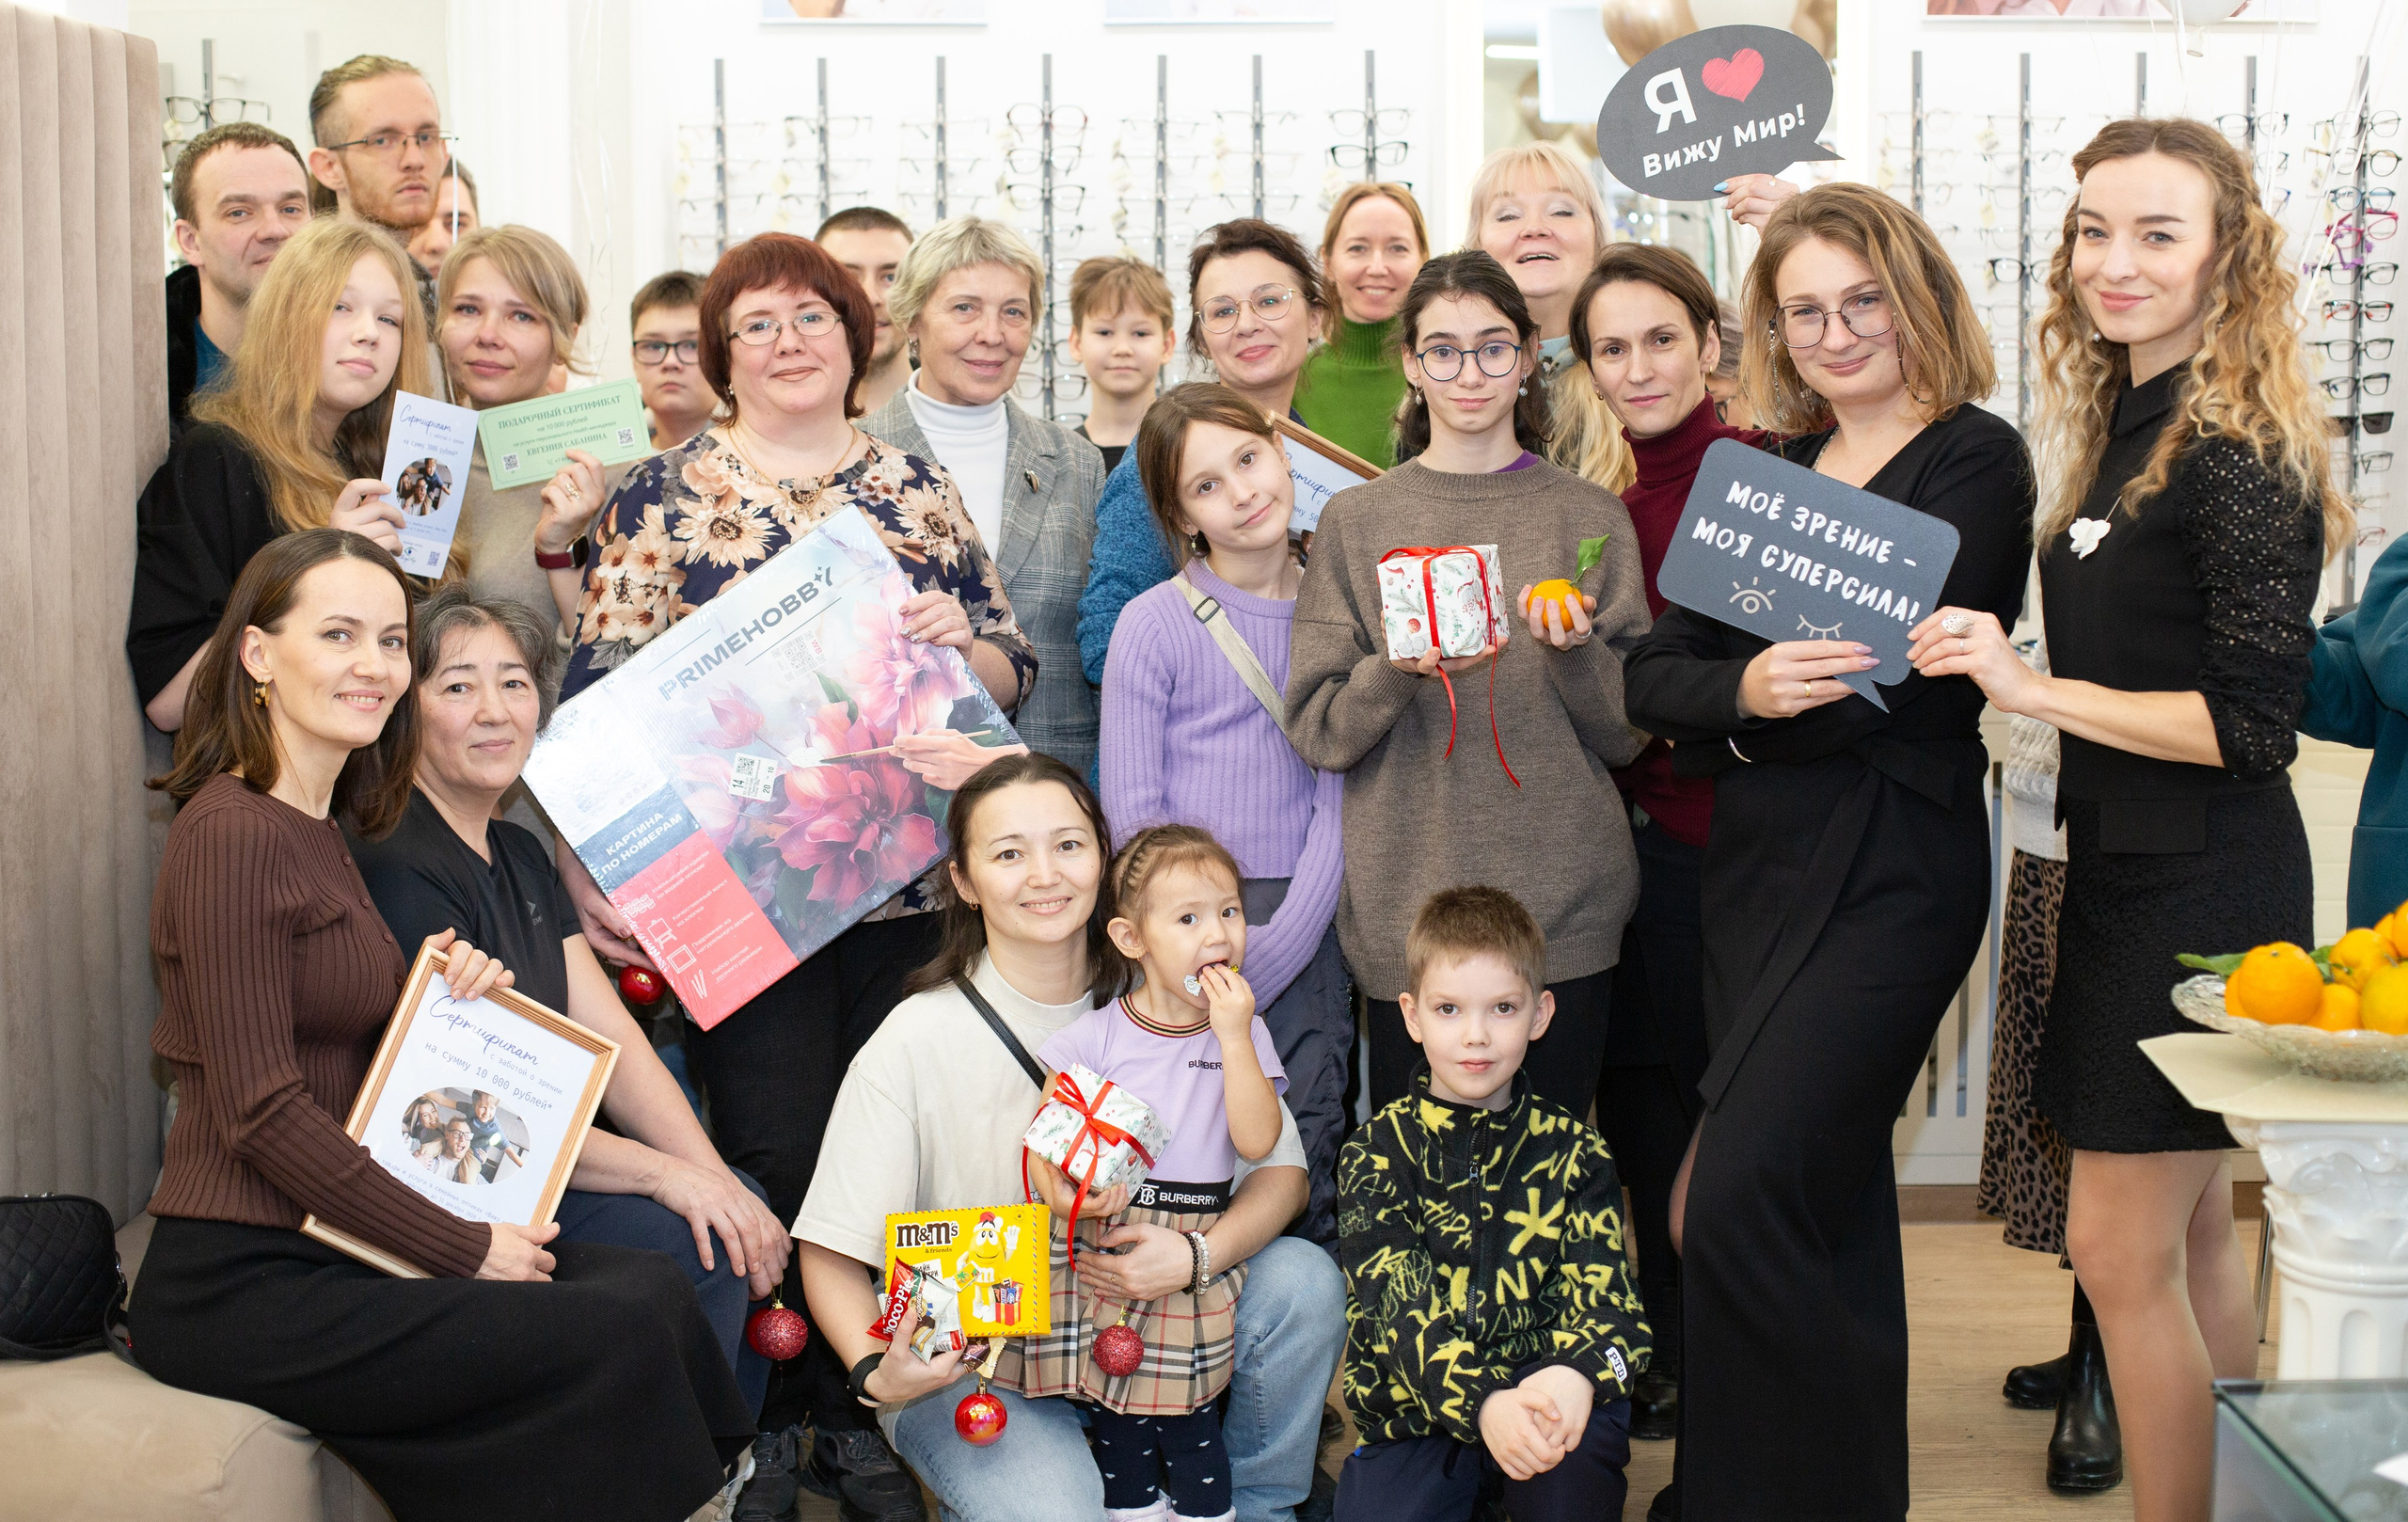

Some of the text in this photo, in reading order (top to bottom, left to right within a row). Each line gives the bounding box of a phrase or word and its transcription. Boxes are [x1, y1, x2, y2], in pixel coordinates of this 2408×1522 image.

[1644, 67, 1697, 134] Я
[1643, 103, 1805, 178] Вижу Мир!
[400, 404, 452, 435] Сертификат
[499, 395, 620, 429] ПОДАРОЧНЫЙ СЕРТИФИКАТ
[527, 433, 607, 455] ЕВГЕНИЯ САБАНИНА
[1726, 481, 1785, 520] МОЁ
[1791, 506, 1894, 563] ЗРЕНИЕ
[1692, 517, 1921, 626] МОЯ СУПЕРСИЛА!
[658, 566, 833, 702] PRIMEHOBBY
[732, 779, 744, 788] 14
[762, 785, 771, 794] 20
[601, 813, 683, 875] ПО НОМЕРАМ
[605, 812, 664, 856] КАРТИНА
[689, 850, 710, 866] краски
[664, 878, 685, 895] водной
[685, 864, 705, 879] основе
[672, 880, 728, 922] Качественный холст
[685, 906, 705, 922] хлопка
[691, 924, 723, 948] Подрамник
[696, 911, 754, 954] натурального дерева
[711, 945, 750, 975] Набор кистей
[716, 945, 763, 984] разного размера
[430, 995, 538, 1065] Сертификат
[425, 1042, 437, 1053] на
[442, 1051, 471, 1070] сумму
[476, 1067, 488, 1078] 10
[492, 1074, 510, 1089] 000
[499, 1057, 527, 1076] заботой
[538, 1078, 563, 1095] зрении
[1188, 1060, 1223, 1070] BURBER
[408, 1174, 427, 1184] услуги
[435, 1186, 459, 1201] семейных
[461, 1199, 483, 1213] оптиках
[1159, 1192, 1218, 1206] BURBERRY
